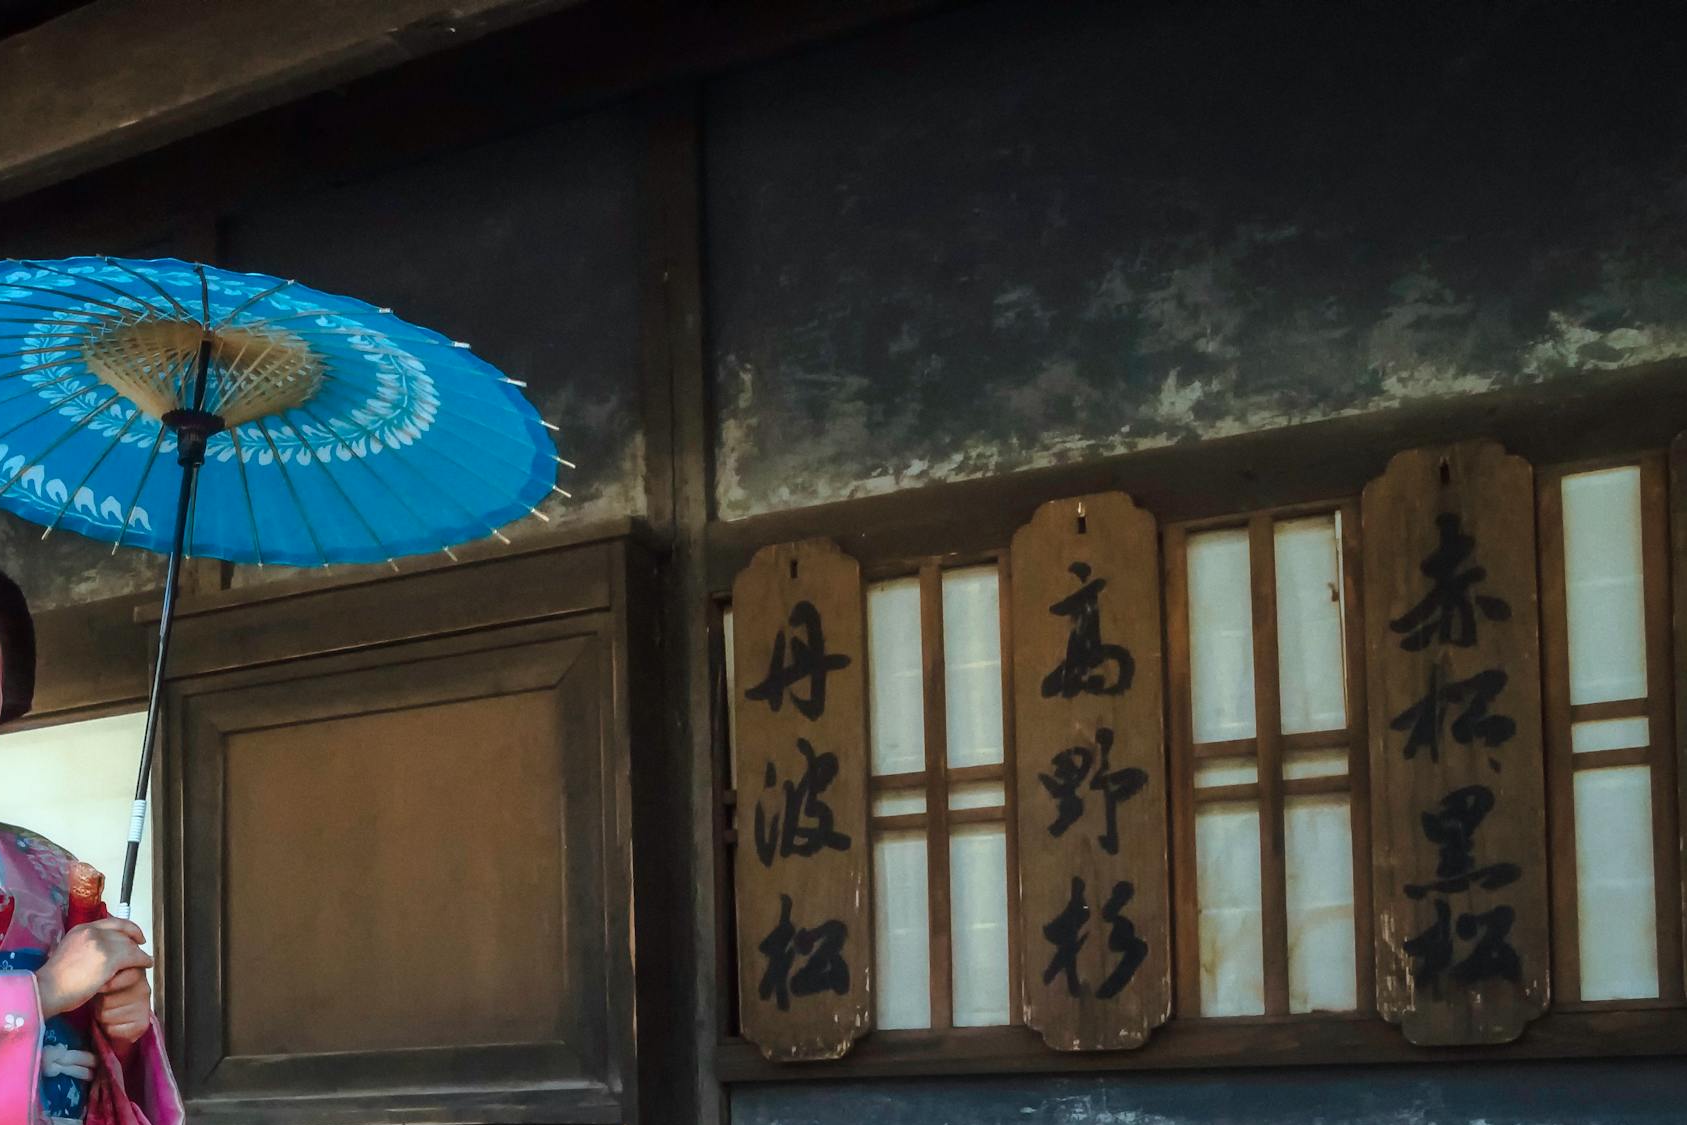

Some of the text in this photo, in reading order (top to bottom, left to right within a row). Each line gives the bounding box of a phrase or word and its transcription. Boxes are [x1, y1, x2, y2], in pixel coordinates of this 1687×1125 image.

[744, 600, 852, 1012] 丹波松
[1037, 561, 1148, 999] 高野杉
